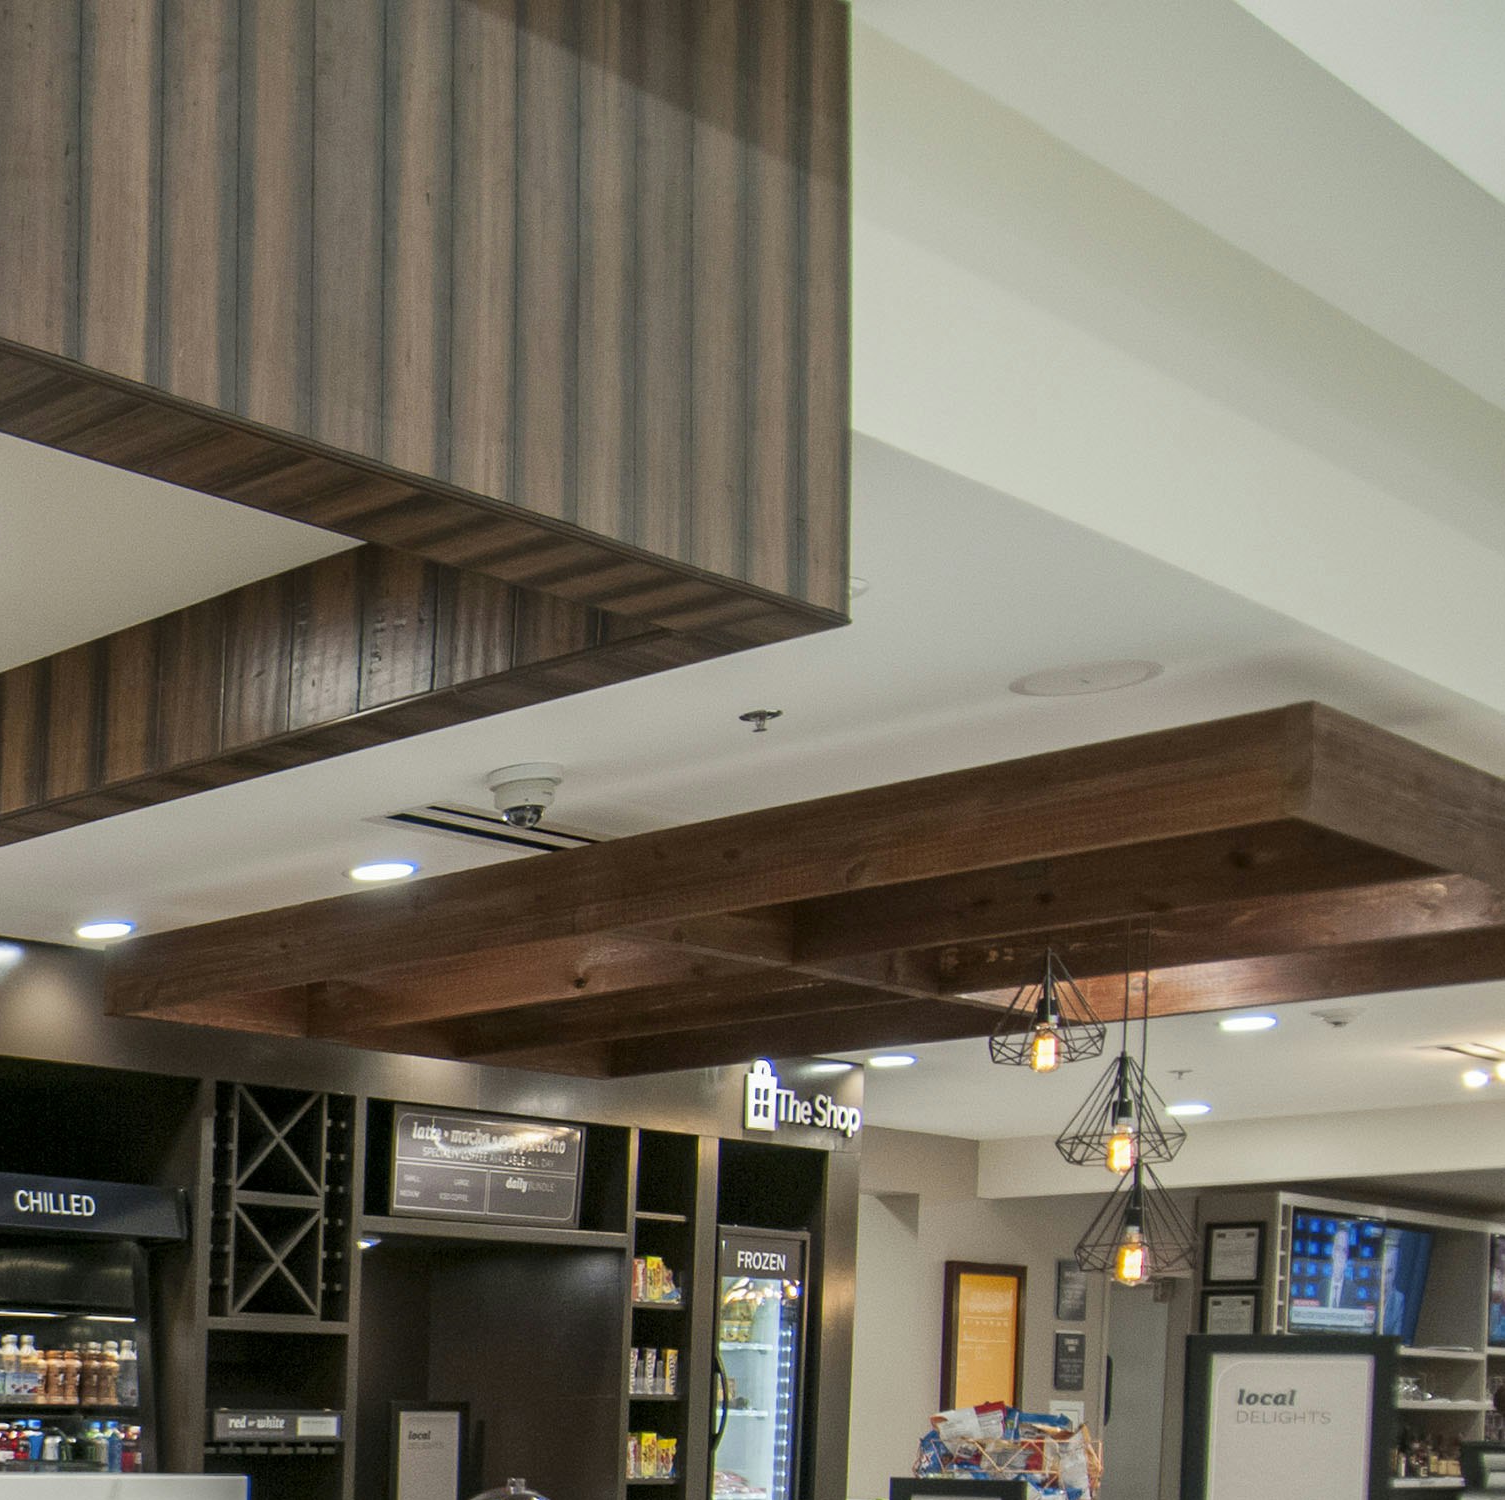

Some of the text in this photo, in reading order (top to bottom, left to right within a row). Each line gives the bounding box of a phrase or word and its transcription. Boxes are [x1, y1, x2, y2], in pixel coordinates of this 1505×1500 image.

[776, 1088, 862, 1138] The Shop
[412, 1122, 442, 1141] latte
[450, 1128, 489, 1147] mocha
[461, 1150, 488, 1163] COFFEE
[505, 1176, 529, 1194] daily
[14, 1189, 96, 1217] CHILLED
[737, 1250, 787, 1272] FROZEN
[1237, 1388, 1297, 1406] local
[229, 1415, 247, 1430] red
[256, 1415, 286, 1430] white
[1236, 1409, 1333, 1425] DELIGHTS
